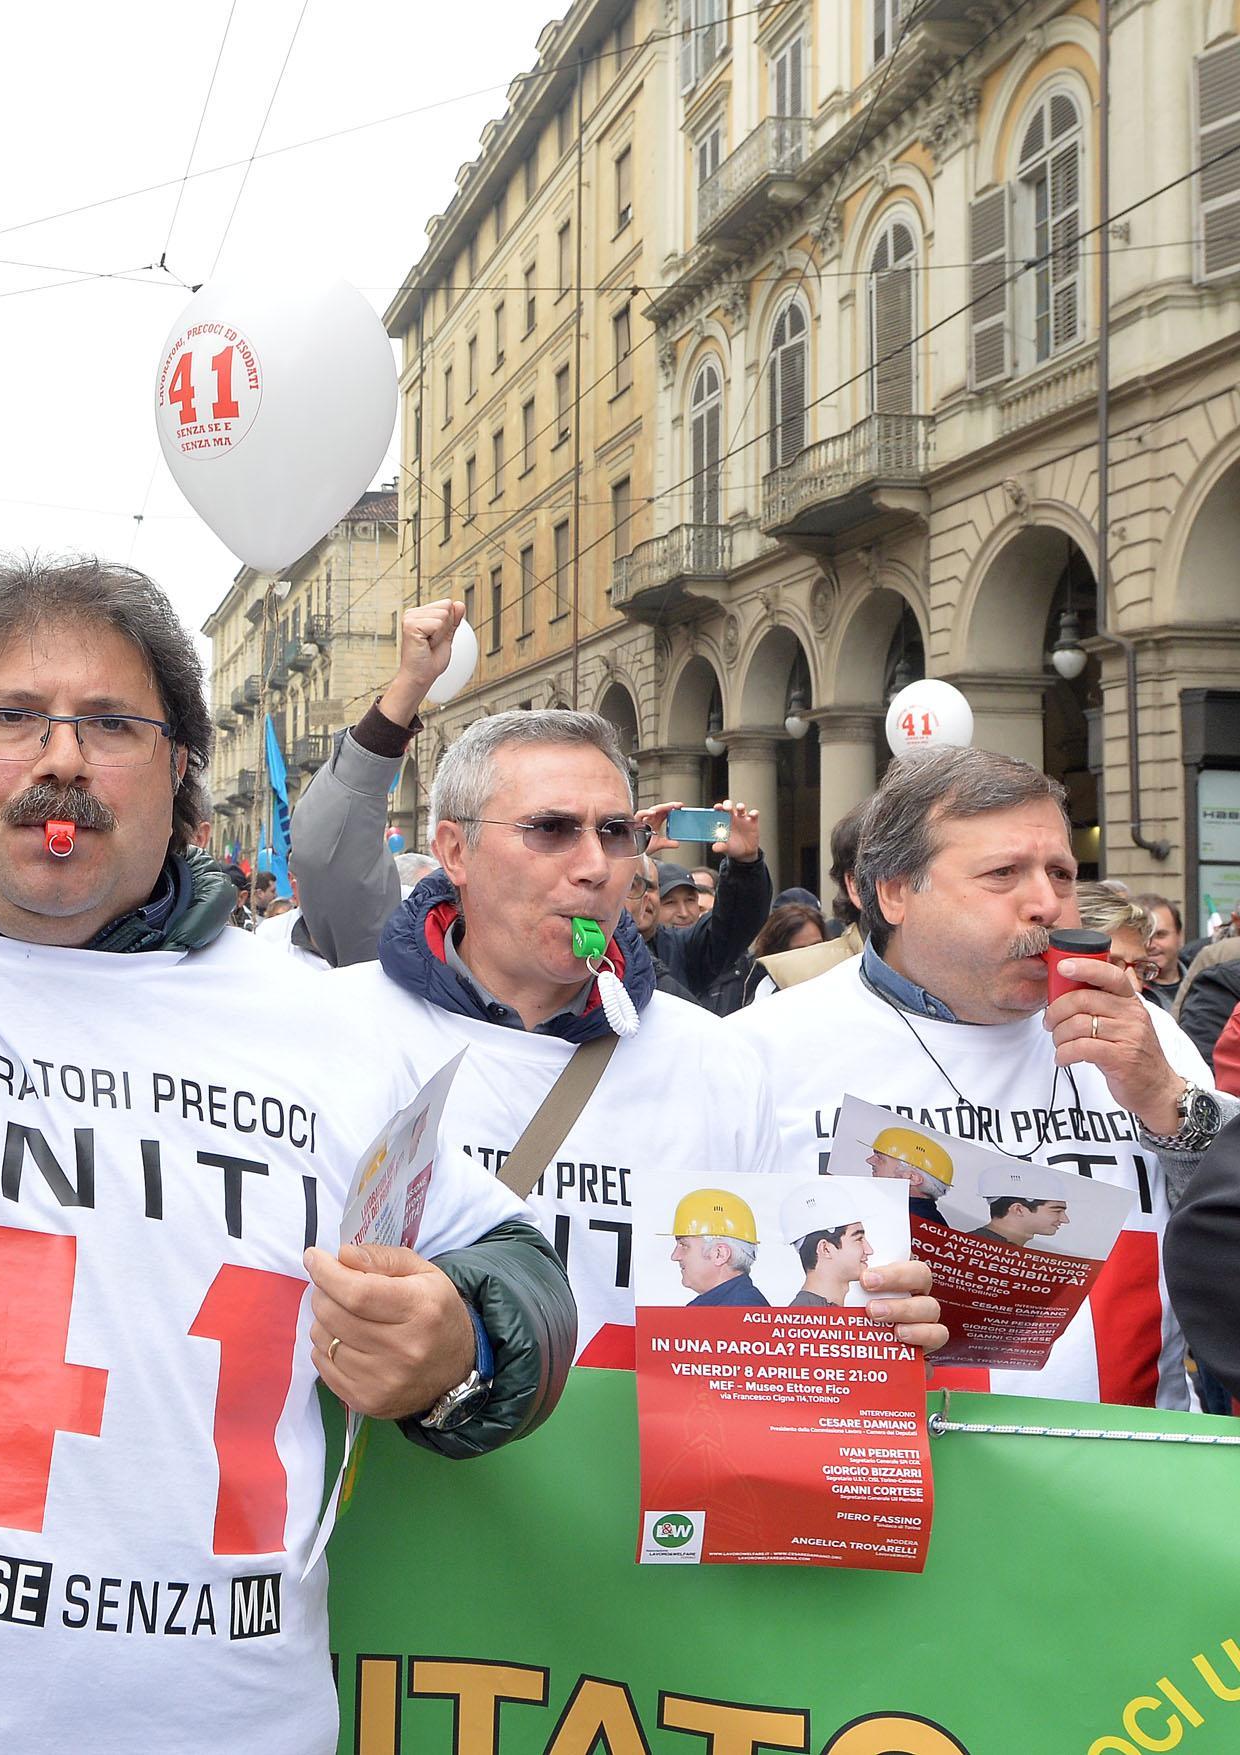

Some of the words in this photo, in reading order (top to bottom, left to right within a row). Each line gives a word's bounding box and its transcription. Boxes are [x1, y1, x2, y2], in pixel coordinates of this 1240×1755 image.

[187, 323, 224, 340] PRECOCI
[224, 328, 238, 342] ED
[235, 339, 259, 391] ESODATI
[168, 345, 240, 425] 41
[176, 425, 206, 439] SENZA
[208, 422, 222, 432] SE
[224, 422, 232, 431] E
[181, 439, 211, 452] SENZA
[213, 437, 232, 447] MA
[902, 712, 932, 736] 41
[153, 1072, 316, 1154] PRECOCI
[1011, 1108, 1139, 1143] PRECOCI
[919, 1222, 948, 1238] AGLI
[949, 1233, 1003, 1254] ANZIANI
[1004, 1248, 1021, 1258] LA
[1023, 1252, 1092, 1271] PENSIONE.
[944, 1241, 958, 1250] AI
[960, 1245, 1016, 1265] GIOVANI
[1017, 1259, 1029, 1268] IL
[1031, 1262, 1088, 1278] LAVORO.
[925, 1260, 974, 1280] APRILE
[977, 1274, 1009, 1288] ORE
[1012, 1282, 1052, 1295] 21:00
[968, 1258, 1086, 1287] FLESSIBILITÀ!
[947, 1275, 985, 1290] Ettore
[986, 1285, 1011, 1296] Fico
[971, 1301, 1013, 1313] CESARE
[1015, 1308, 1067, 1317] DAMIANO
[743, 1313, 772, 1323] AGLI
[774, 1314, 827, 1325] ANZIANI
[830, 1316, 845, 1326] LA
[983, 1317, 1010, 1325] IVAN
[772, 1328, 785, 1338] AI
[788, 1329, 842, 1340] GIOVANI
[845, 1331, 856, 1340] IL
[962, 1323, 1006, 1333] GIORGIO
[966, 1332, 1005, 1341] GIANNI
[651, 1338, 670, 1351] IN
[674, 1339, 713, 1353] UNA
[716, 1341, 796, 1356] PAROLA?
[799, 1344, 916, 1361] FLESSIBILITÀ!
[744, 1366, 754, 1377] 8
[757, 1367, 810, 1380] APRILE
[813, 1369, 845, 1381] ORE
[848, 1370, 888, 1383] 21:00
[709, 1380, 735, 1390] MEF
[746, 1382, 784, 1392] Museo
[786, 1382, 823, 1394] Ettore
[826, 1384, 851, 1395] Fico
[733, 1393, 772, 1401] Francesco
[773, 1395, 795, 1403] Cigna
[859, 1410, 916, 1418] INTERVENGONO
[819, 1418, 861, 1428] CESARE
[863, 1419, 917, 1430] DAMIANO
[839, 1447, 866, 1457] IVAN
[868, 1448, 920, 1459] PEDRETTI
[822, 1465, 870, 1475] GIORGIO
[871, 1467, 922, 1478] BIZZARRI
[831, 1484, 871, 1494] GIANNI
[873, 1486, 924, 1497] CORTESE
[836, 1512, 871, 1521] PIERO
[873, 1515, 922, 1526] FASSINO
[791, 1536, 848, 1549] ANGELICA
[849, 1541, 918, 1555] TROVARELLI
[886, 1538, 919, 1546] MODERA
[62, 1574, 216, 1636] SENZA
[232, 1577, 281, 1637] MA
[354, 1652, 972, 1755] ITAT
